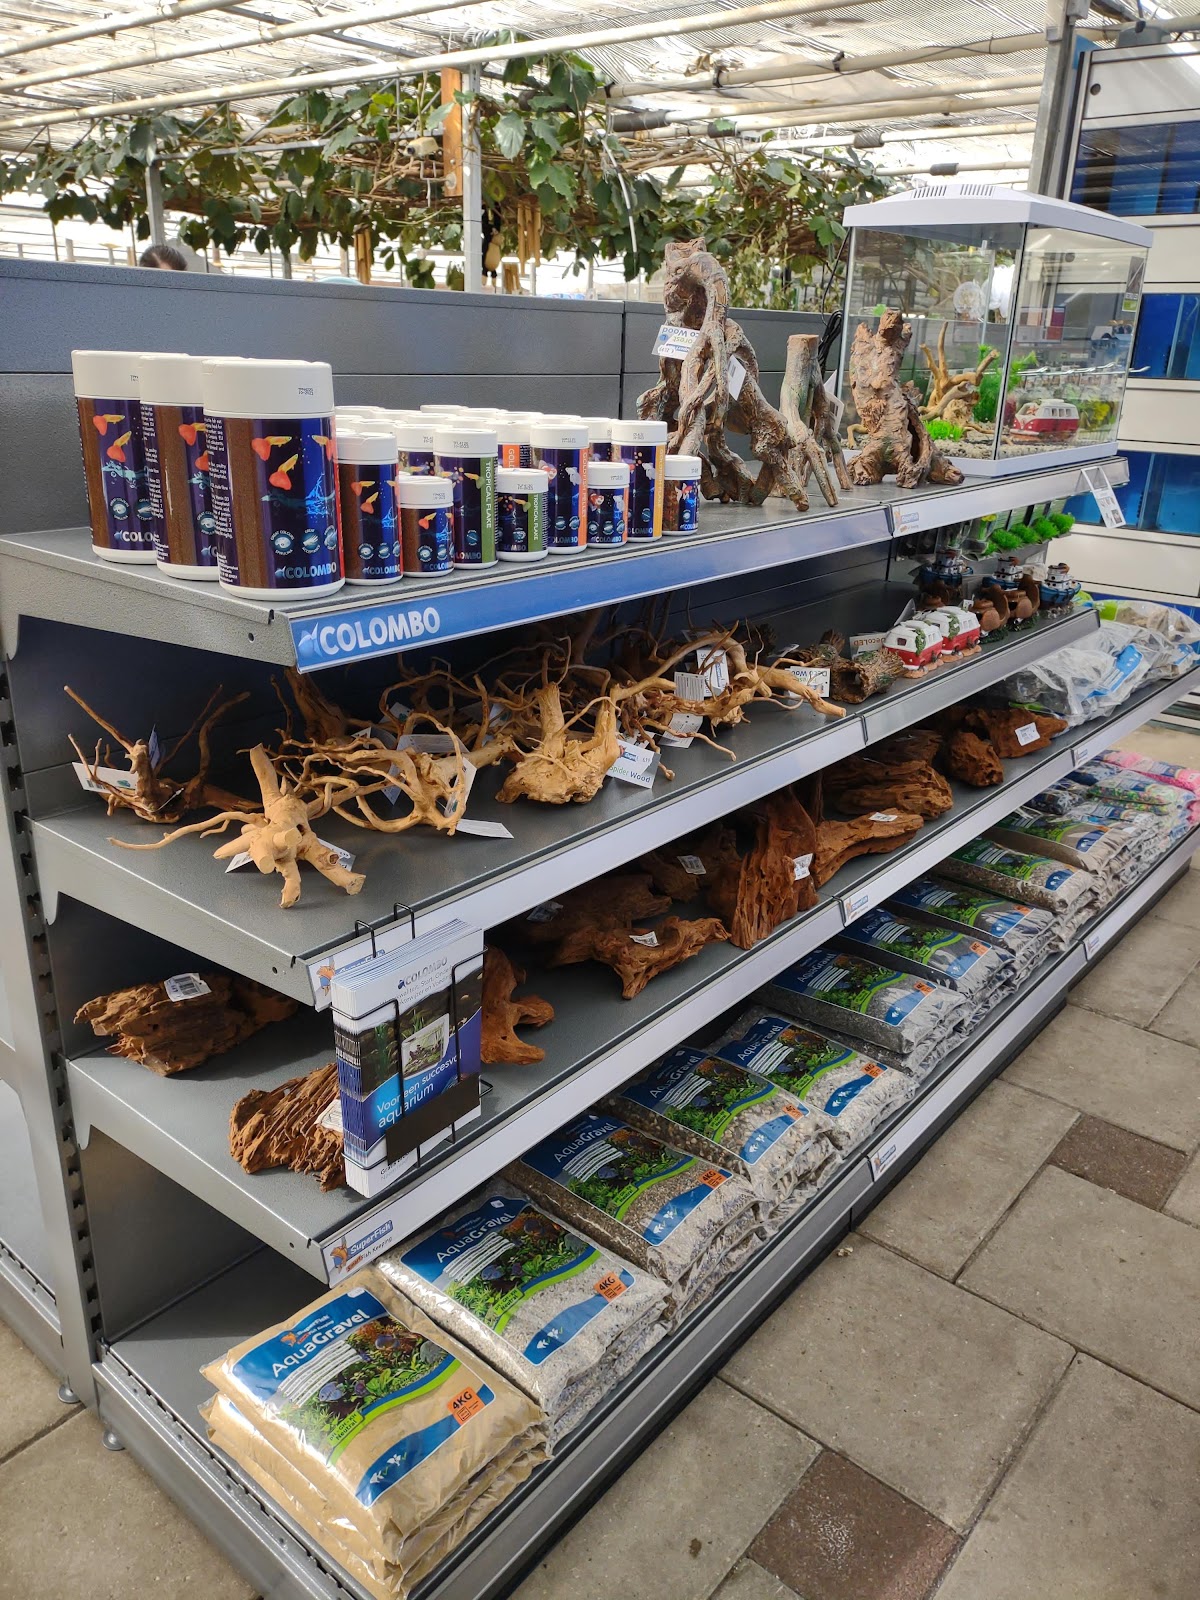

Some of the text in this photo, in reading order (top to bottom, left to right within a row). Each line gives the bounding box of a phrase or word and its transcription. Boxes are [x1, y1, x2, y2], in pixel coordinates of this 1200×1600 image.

[661, 327, 688, 337] Wood
[674, 335, 692, 344] orest
[122, 531, 153, 542] COLO
[456, 552, 481, 560] LOMBO
[286, 562, 337, 579] COLOMBO
[319, 607, 441, 655] COLOMBO
[630, 771, 651, 783] Wood
[405, 957, 448, 985] COLOMBO
[649, 1055, 702, 1099] AquaGravel
[376, 1094, 400, 1113] Voor
[403, 1082, 420, 1098] een
[378, 1083, 434, 1128] aquarium
[553, 1122, 618, 1163] AquaGravel
[702, 1170, 717, 1182] 4KG
[350, 1219, 393, 1255] SuperFish
[436, 1213, 516, 1264] AquaGravel
[346, 1255, 364, 1273] Smart
[372, 1236, 393, 1253] Keeping
[599, 1276, 616, 1291] 4KG
[272, 1308, 370, 1378] AquaGravel
[452, 1390, 473, 1410] 4KG
[335, 1420, 358, 1442] Neutral
